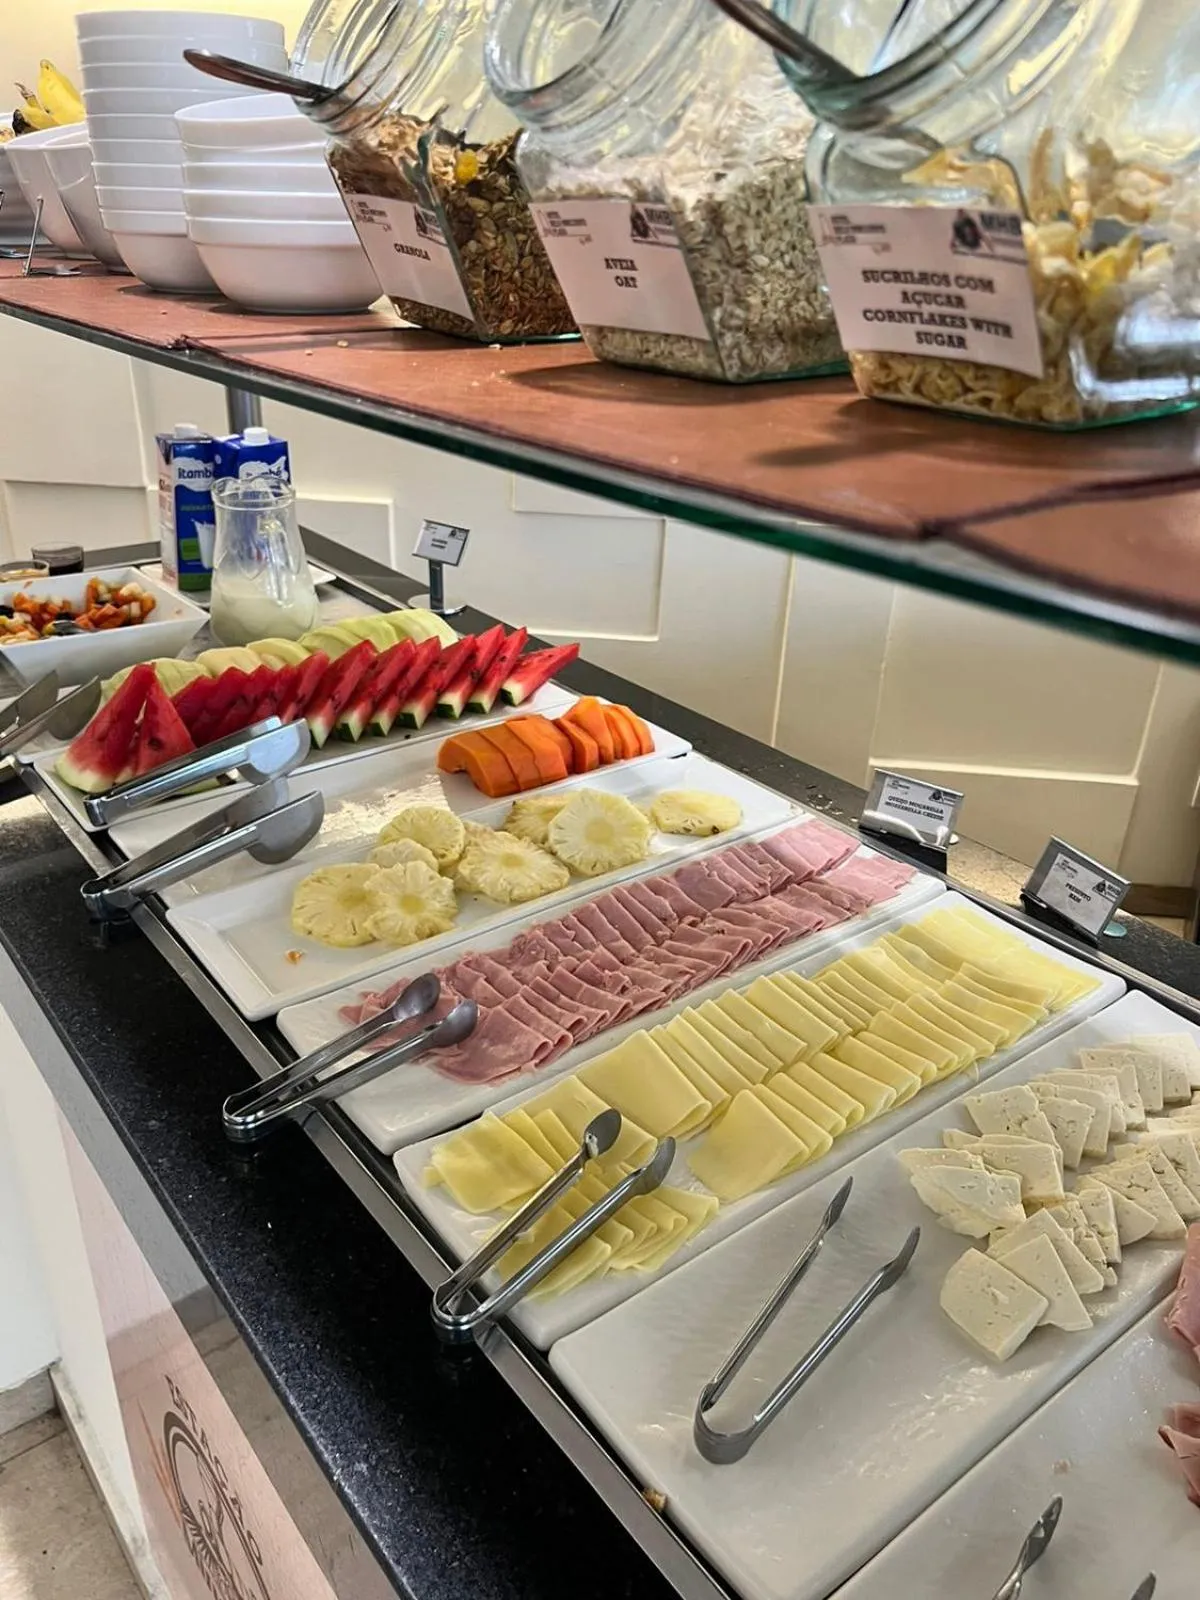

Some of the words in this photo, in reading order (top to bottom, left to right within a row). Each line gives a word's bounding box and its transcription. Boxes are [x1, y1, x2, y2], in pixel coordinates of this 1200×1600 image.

[393, 243, 431, 261] GRANOLA
[604, 257, 638, 272] AVEIA
[614, 275, 638, 289] OAT
[862, 269, 952, 288] SUCRILHOS
[954, 275, 996, 295] COM
[901, 290, 967, 310] AÇUCAR
[863, 309, 968, 330] CORNFLAKES
[969, 317, 1014, 339] WITH
[915, 331, 968, 350] SUGAR
[1065, 883, 1092, 902] PRESUNTO
